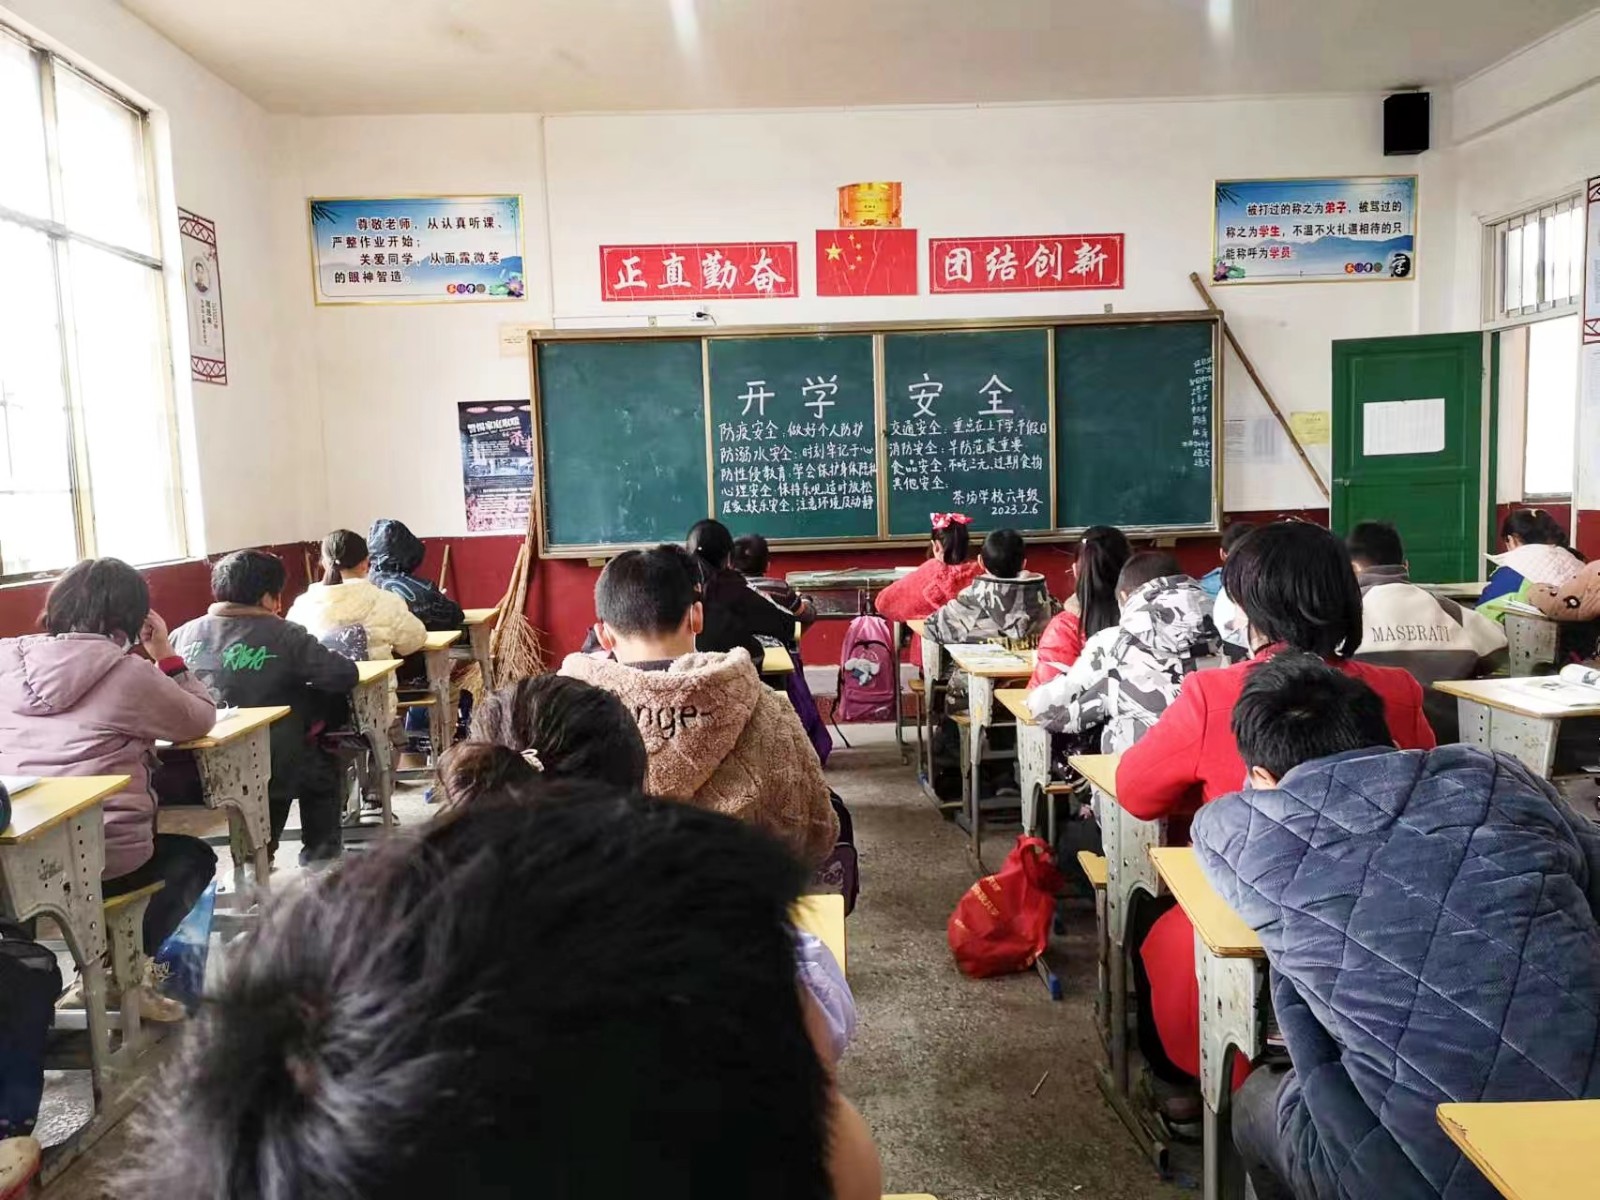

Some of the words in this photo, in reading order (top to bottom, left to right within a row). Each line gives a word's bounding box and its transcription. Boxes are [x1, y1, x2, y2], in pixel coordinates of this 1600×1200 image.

[942, 241, 1108, 284] 团结创新
[1225, 246, 1291, 260] 能称呼为学员
[612, 247, 787, 292] 正直勤奋
[737, 374, 839, 419] 开学
[908, 373, 1014, 418] 安全
[991, 503, 1039, 515] 2023.2.6
[1372, 625, 1450, 642] MASERATI
